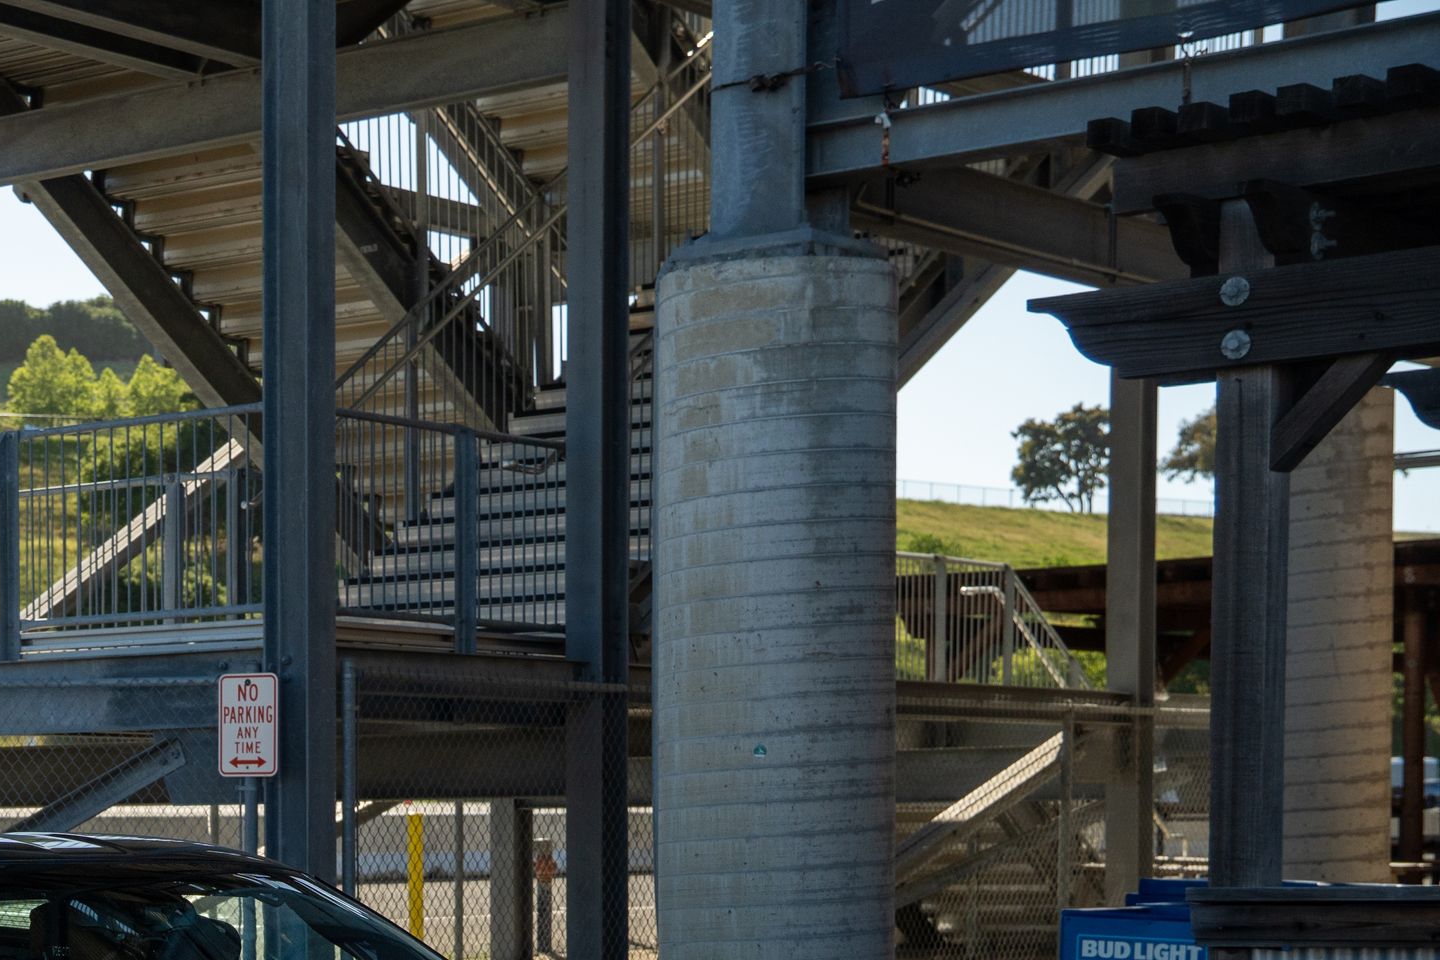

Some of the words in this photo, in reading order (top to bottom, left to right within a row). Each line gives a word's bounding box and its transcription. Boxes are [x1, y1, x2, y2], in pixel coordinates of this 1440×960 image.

[237, 683, 258, 702] NO
[223, 705, 273, 724] PARKING
[236, 726, 259, 739] ANY
[234, 741, 262, 754] TIME
[1081, 939, 1130, 960] BUD
